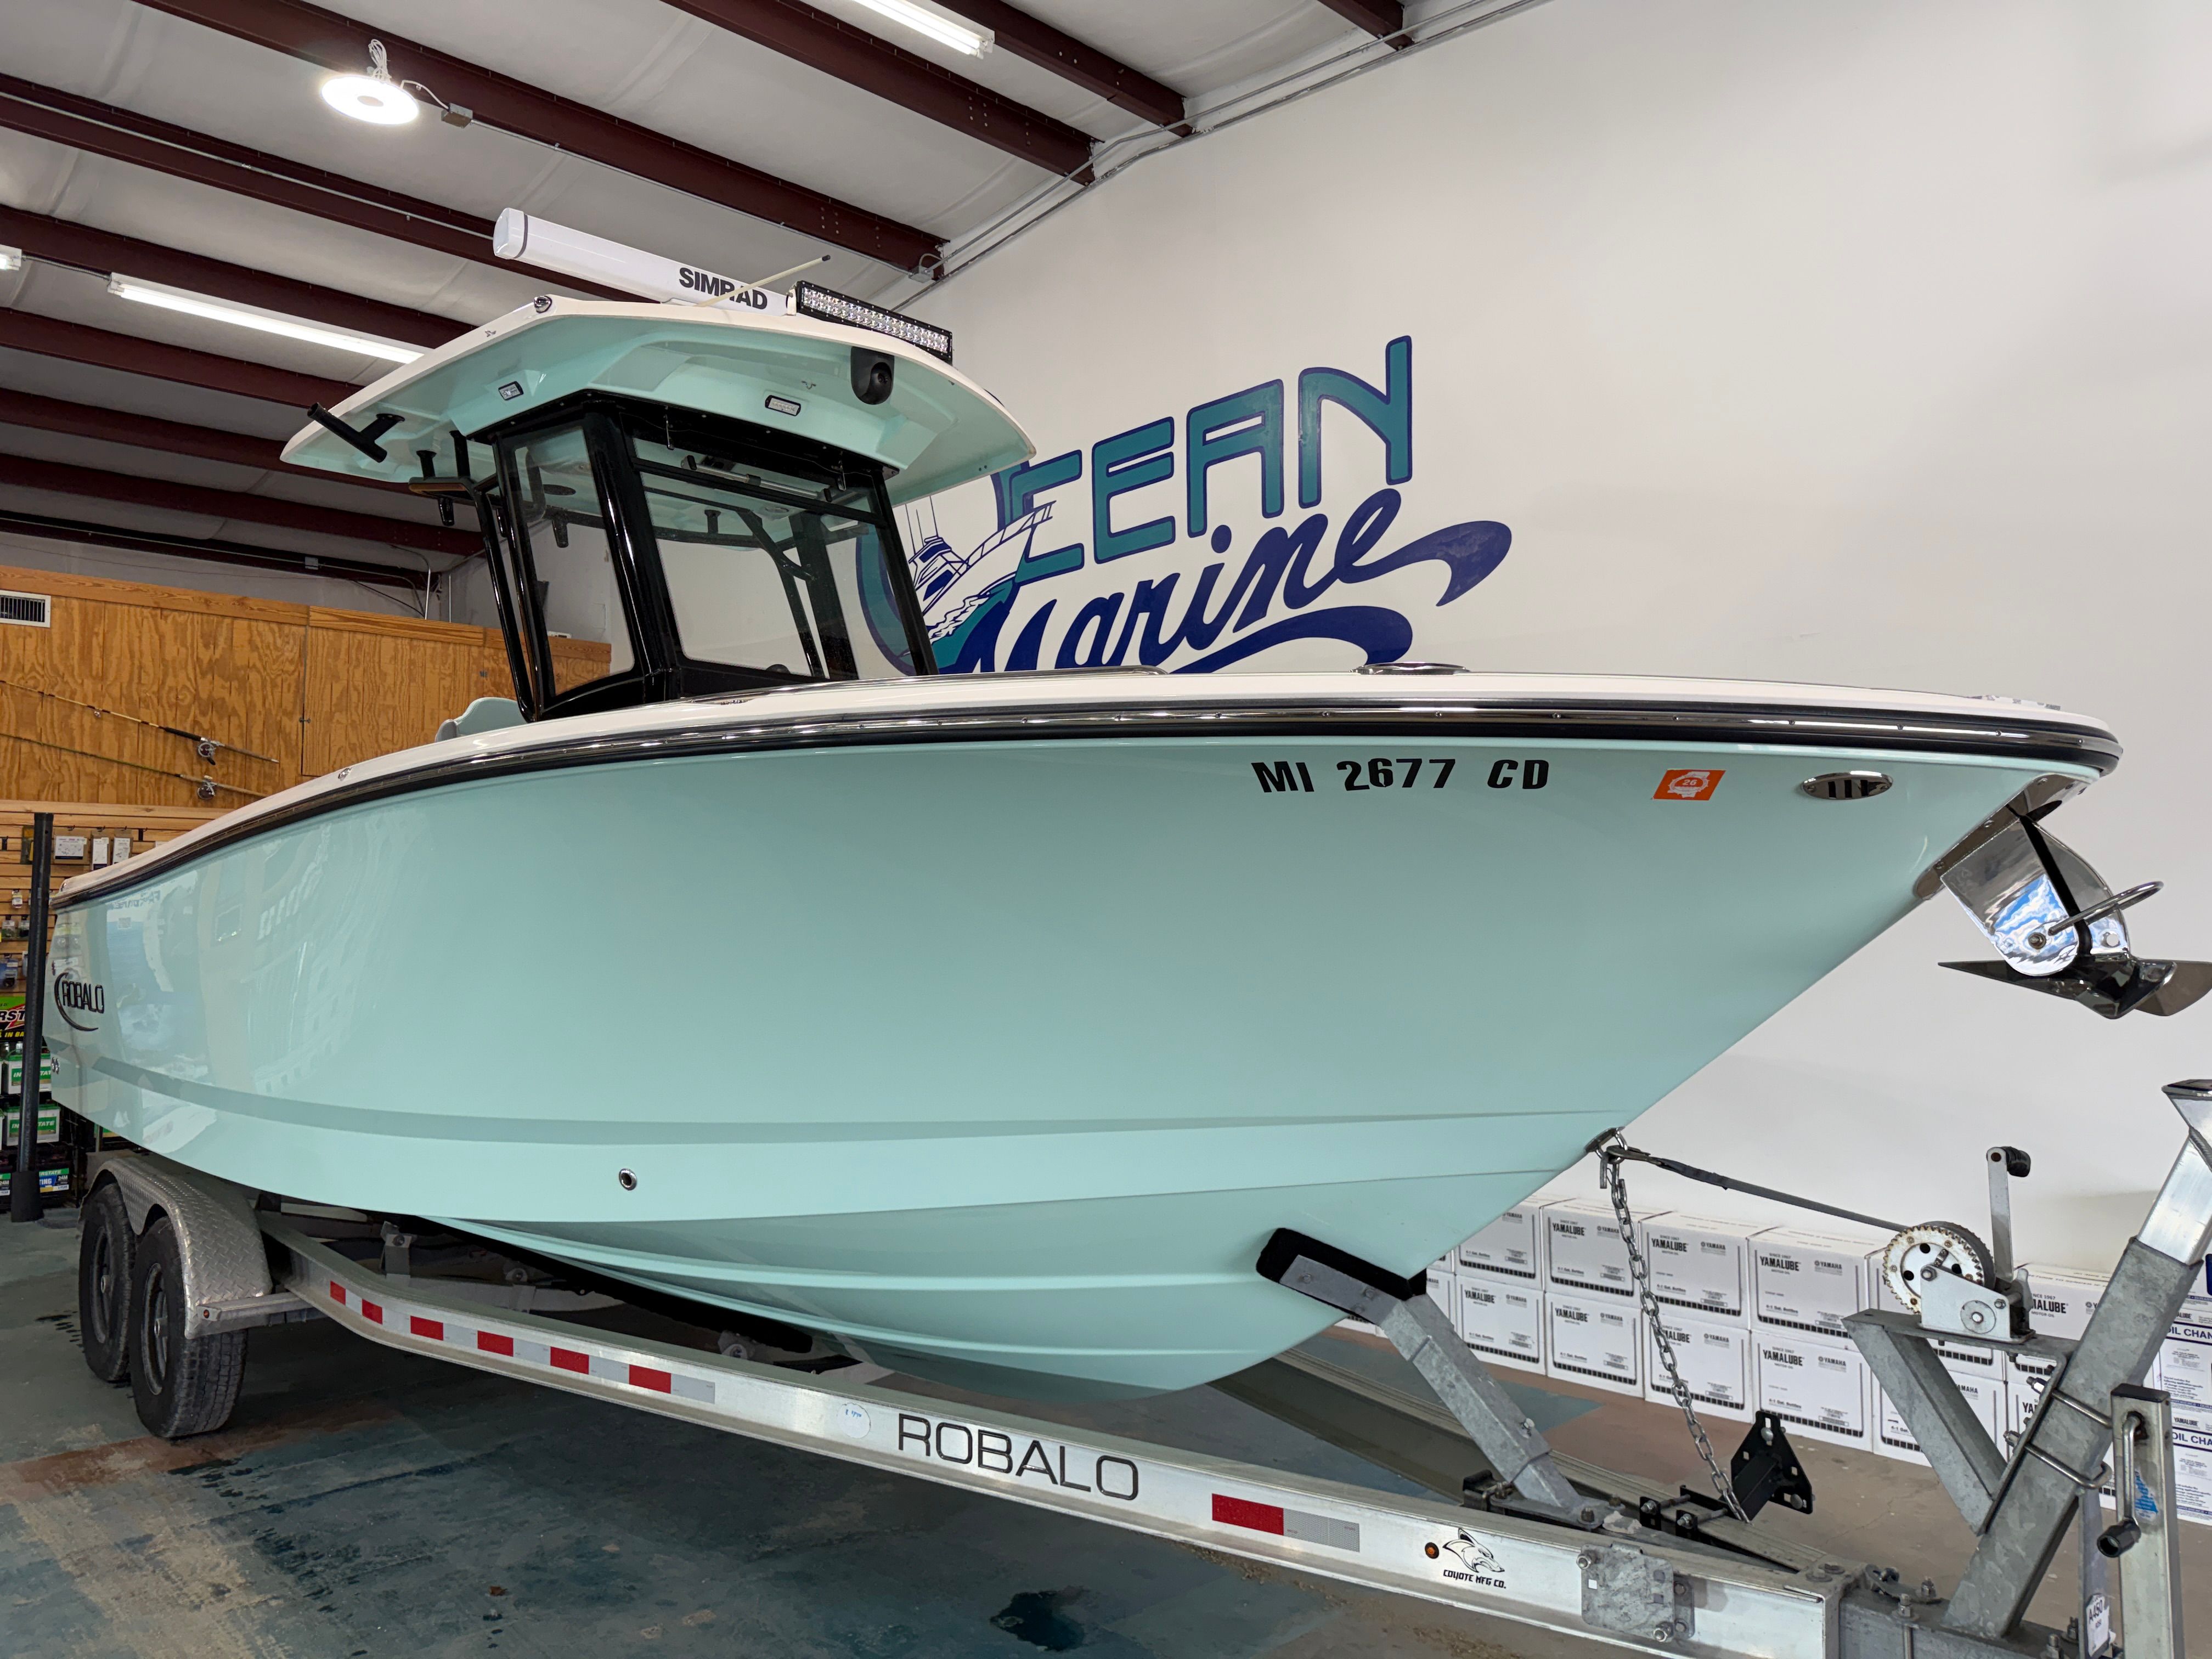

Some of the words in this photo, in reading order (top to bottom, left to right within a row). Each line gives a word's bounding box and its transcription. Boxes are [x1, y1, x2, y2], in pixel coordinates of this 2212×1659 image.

[679, 267, 768, 310] SIMRAD
[1251, 761, 1314, 793] MI
[1337, 758, 1455, 792] 2677
[1487, 759, 1550, 790] CD
[61, 980, 105, 1014] ROBALO
[1553, 1223, 1585, 1236] YAMALUBE
[1651, 1238, 1688, 1252] YAMALUBE
[1760, 1256, 1799, 1272] YAMALUBE
[1820, 1261, 1842, 1270] YAMAHA
[1465, 1289, 1495, 1304] YAMALUBE
[2033, 1299, 2067, 1314] ALUBE
[1555, 1307, 1588, 1322] YAMALUBE
[1605, 1313, 1623, 1322] YAMAHA
[2184, 1328, 2212, 1339] CHAN
[1763, 1350, 1803, 1366] YAMALUBE
[1824, 1357, 1847, 1367] YAMAHA
[1957, 1384, 1978, 1394] AMAHA
[2172, 1432, 2188, 1442] OIL
[2191, 1436, 2212, 1446] CHA
[898, 1413, 1139, 1500] ROBALO
[1443, 1569, 1474, 1582] COYOTE
[1476, 1575, 1492, 1585] MFG
[1493, 1579, 1506, 1589] CO.
